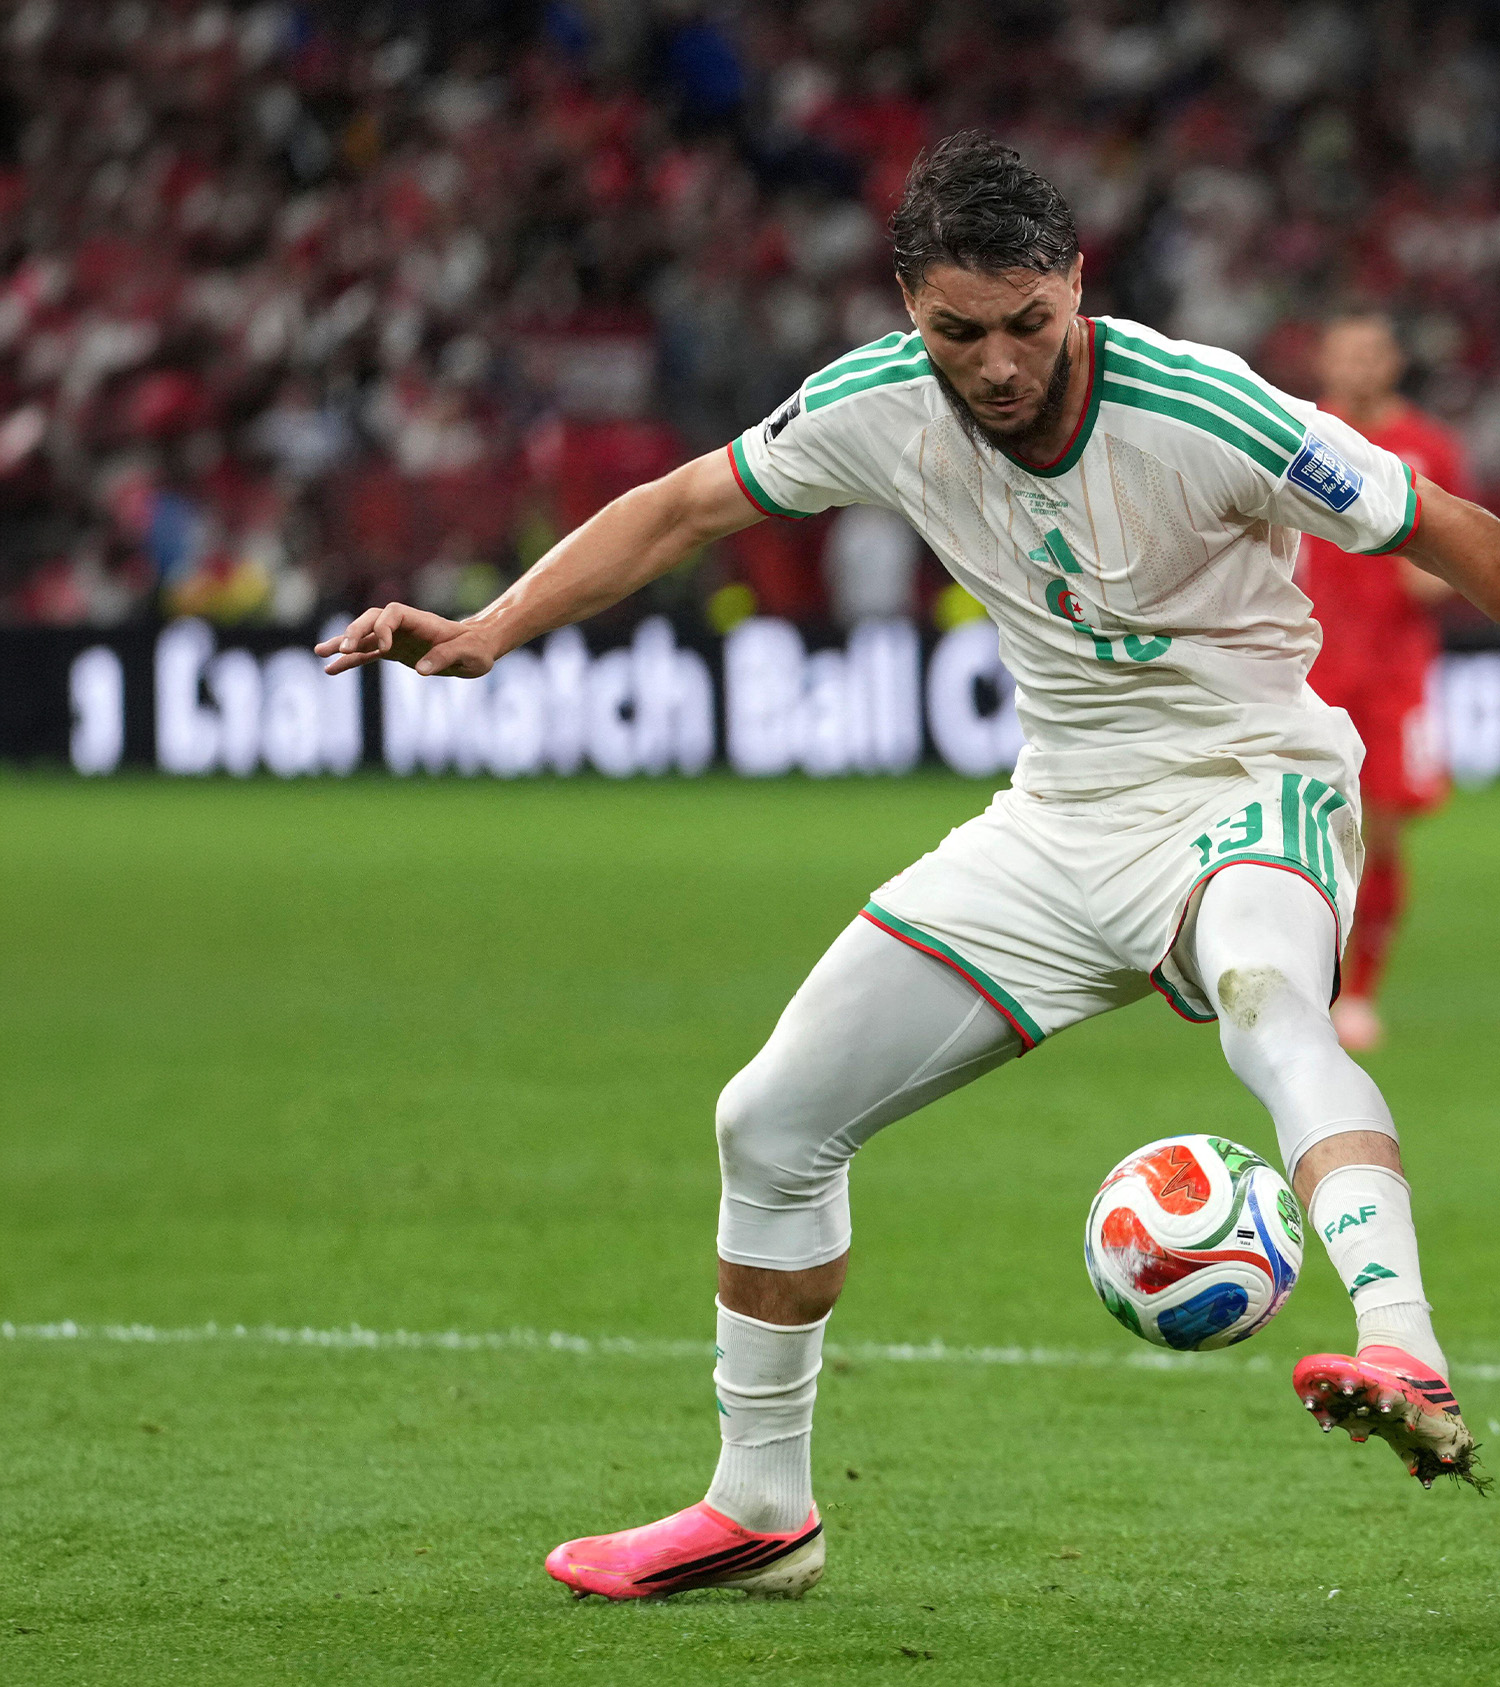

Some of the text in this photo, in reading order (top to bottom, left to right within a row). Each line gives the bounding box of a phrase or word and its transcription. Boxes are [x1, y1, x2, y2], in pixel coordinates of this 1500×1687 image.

[1321, 481, 1337, 495] the
[380, 614, 715, 777] Match
[724, 614, 924, 777] Ball
[1189, 801, 1263, 868] 13
[1323, 1204, 1377, 1243] FAF
